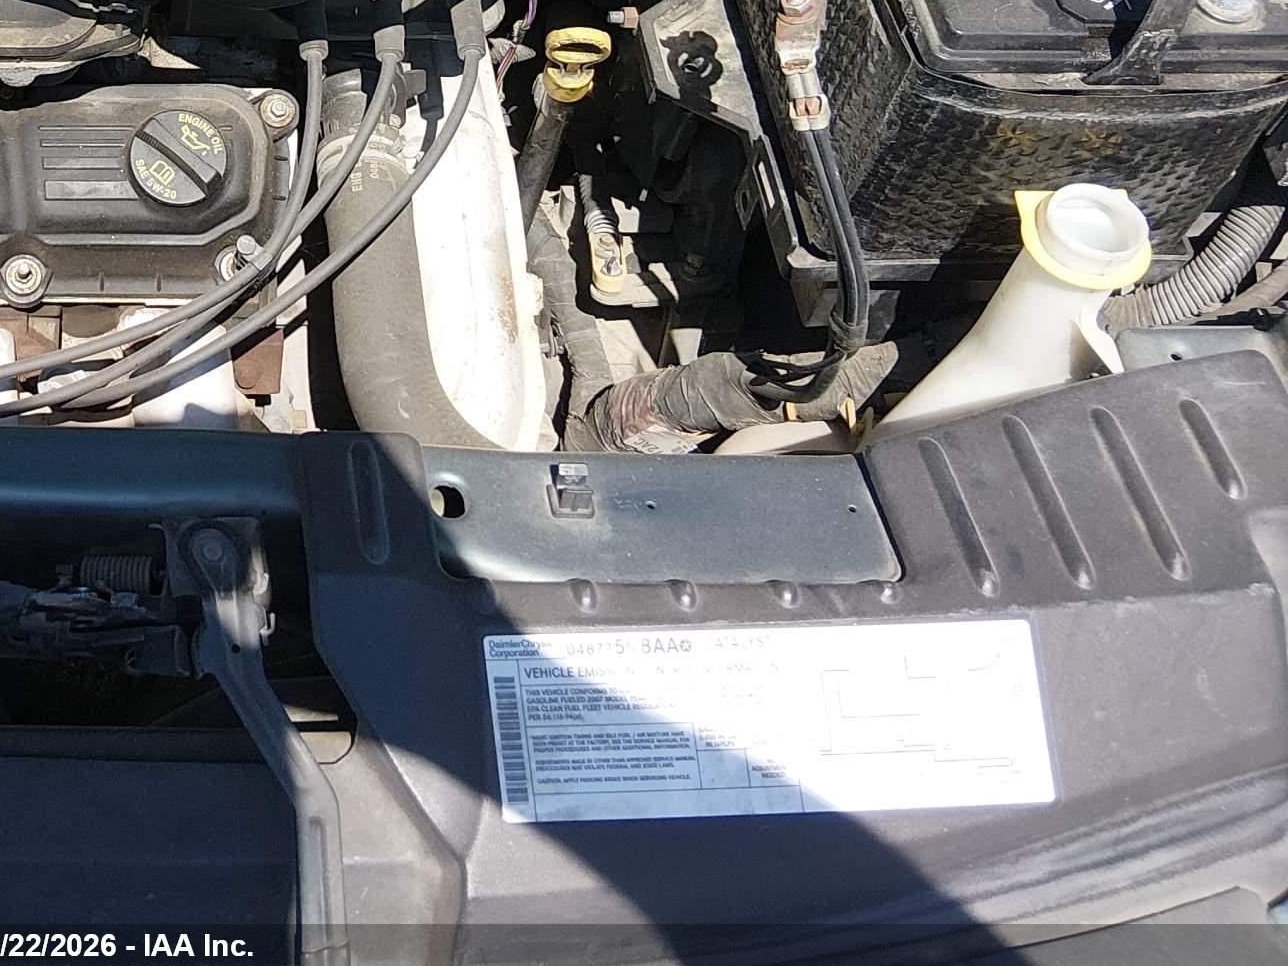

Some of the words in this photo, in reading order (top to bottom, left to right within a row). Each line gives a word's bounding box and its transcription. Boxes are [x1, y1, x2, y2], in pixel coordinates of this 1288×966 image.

[178, 113, 214, 138] ENGINE
[211, 136, 224, 154] OIL
[136, 159, 148, 179] SAE
[147, 178, 177, 199] 5W-20
[489, 640, 552, 650] DaimlerChry
[489, 648, 540, 658] Corporation
[524, 666, 574, 679] VEHICLE
